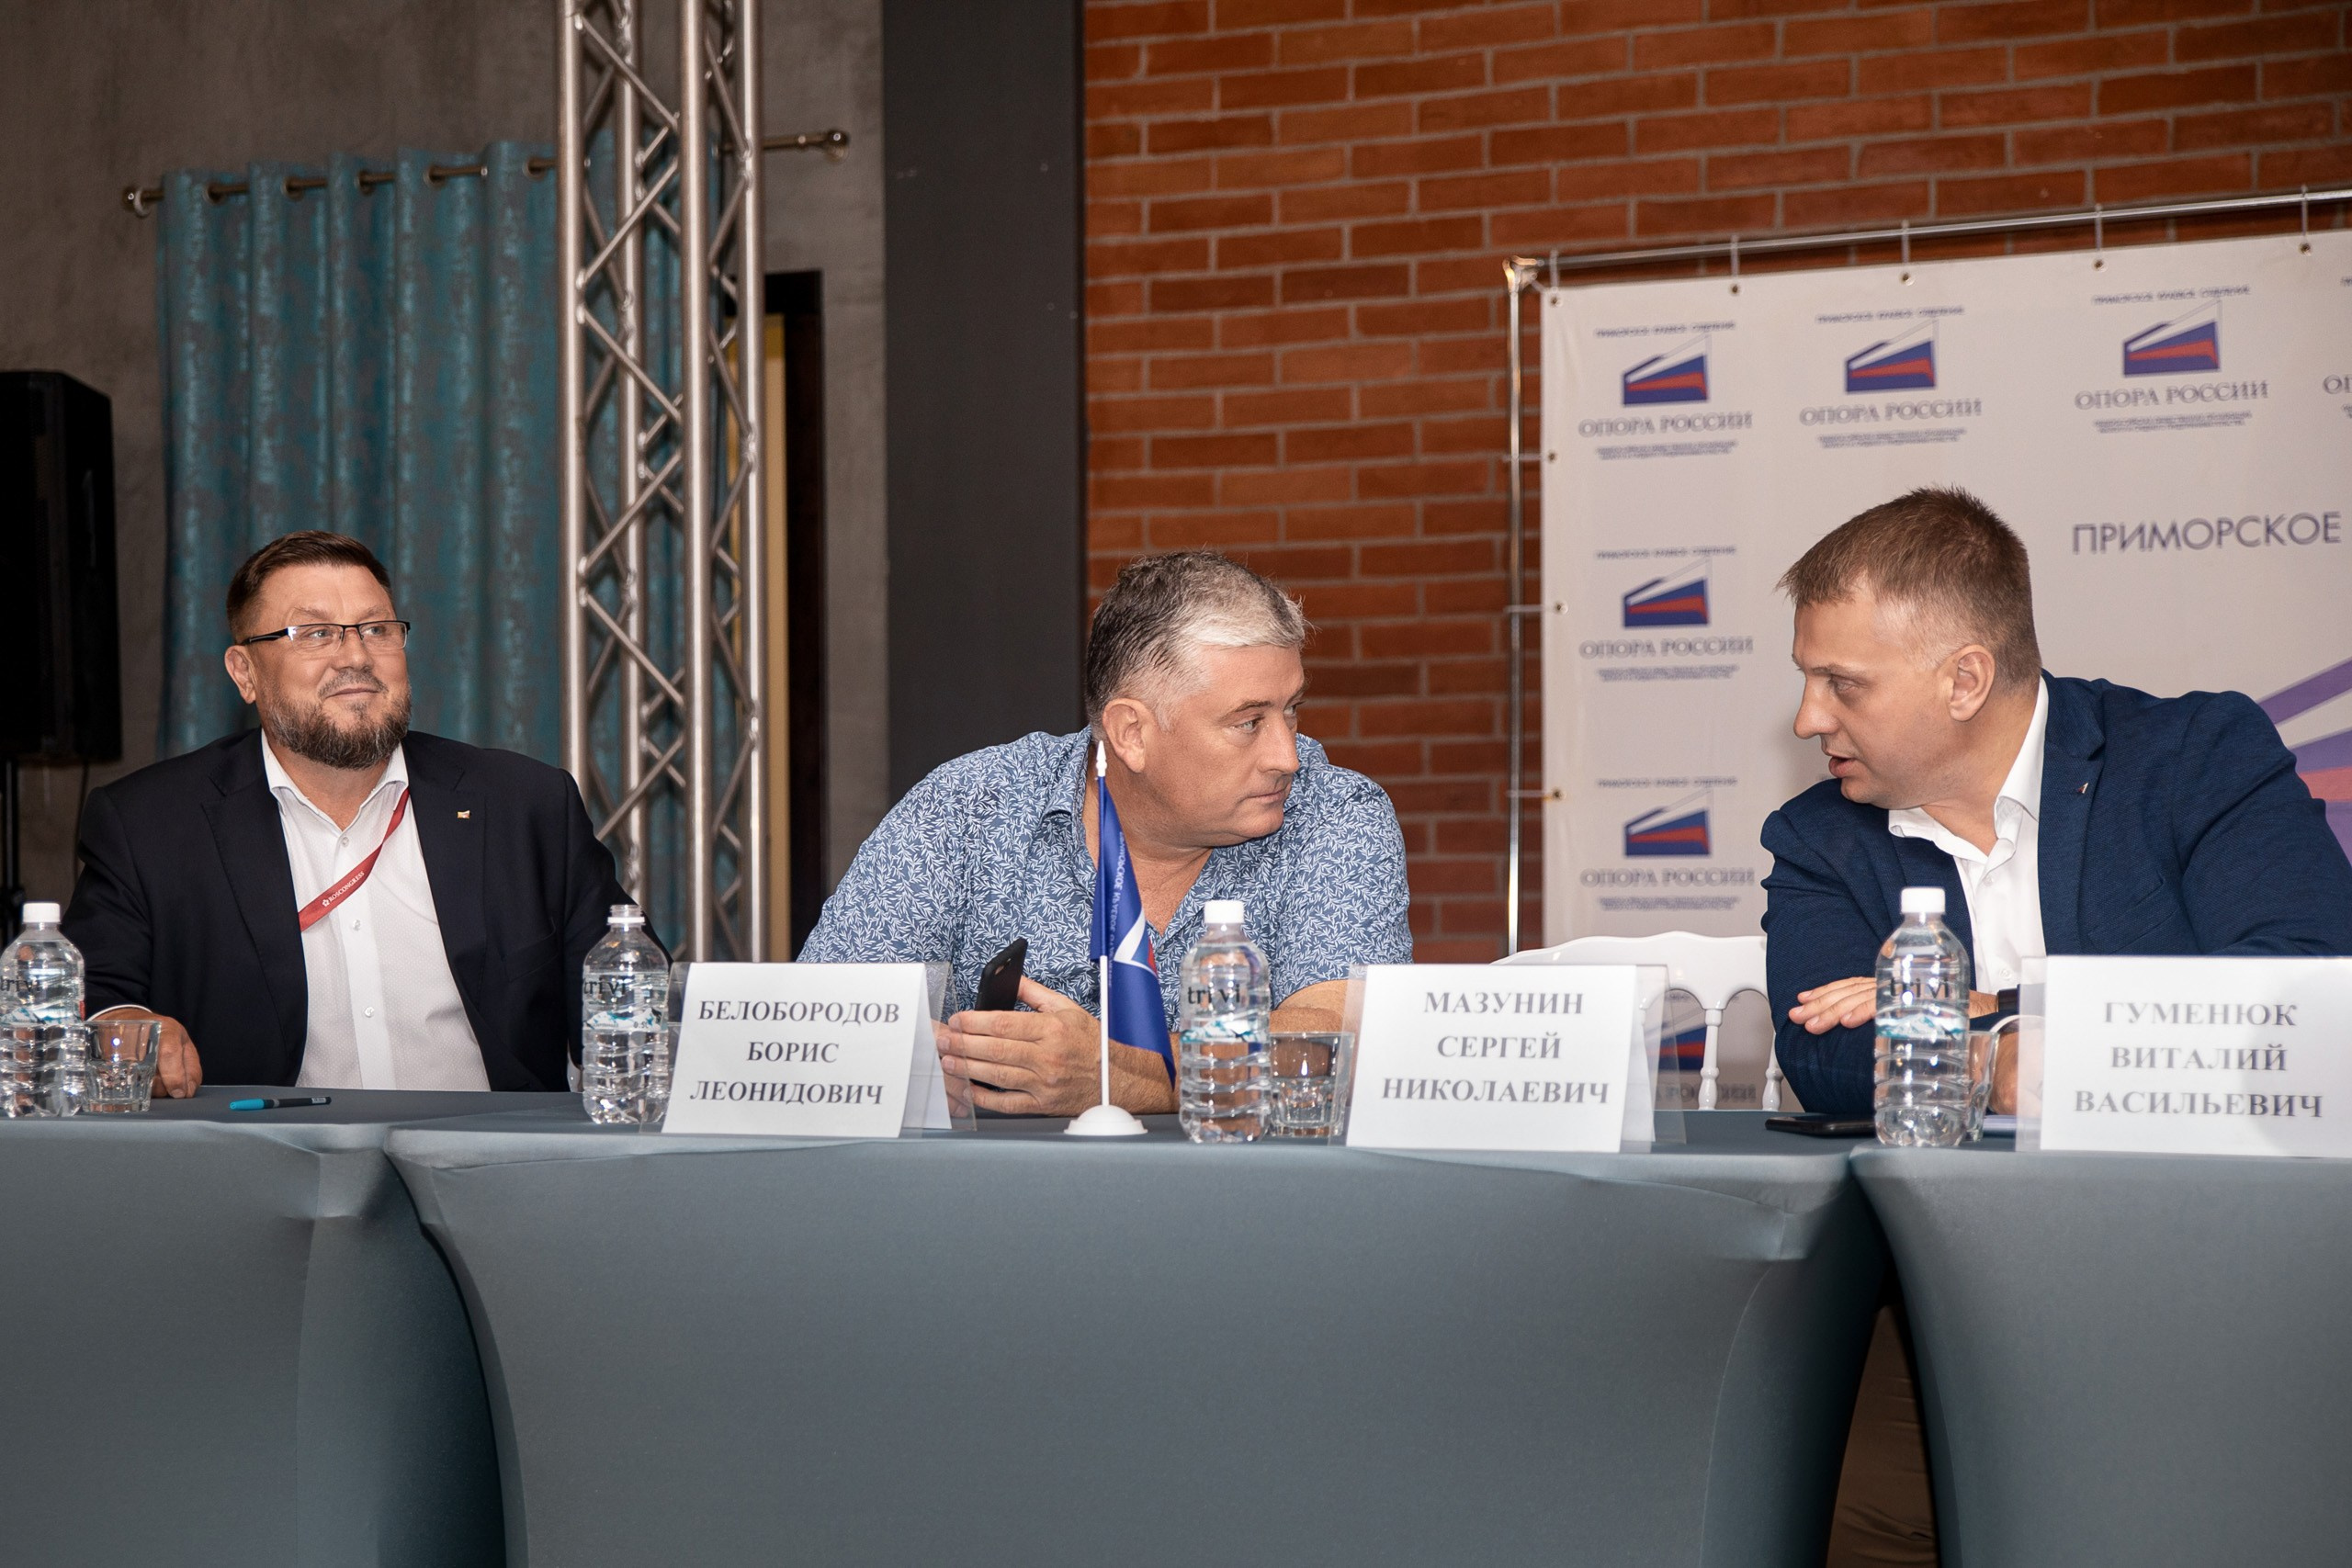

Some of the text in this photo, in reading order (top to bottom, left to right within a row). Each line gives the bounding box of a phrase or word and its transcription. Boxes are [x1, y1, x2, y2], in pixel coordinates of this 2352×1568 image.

[2075, 380, 2268, 411] ОПОРА РОССИИ
[1578, 412, 1753, 438] ОПОРА РОССИИ
[1800, 399, 1982, 426] ОПОРА РОССИИ
[2073, 511, 2342, 555] ПРИМОРСКОЕ
[1579, 636, 1753, 660] ОПОРА РОССИИ
[1580, 867, 1755, 888] ОПОРА РОССИИ
[1188, 984, 1240, 1004] trivi
[1424, 992, 1583, 1014] МАЗУНИН
[699, 1000, 899, 1025] БЕЛОБОРОДОВ
[2105, 1002, 2297, 1027] ГУМЕНЮК
[747, 1042, 839, 1063] БОРИС
[1437, 1032, 1561, 1059] СЕРГЕЙ
[2111, 1043, 2288, 1072] ВИТАЛИЙ
[690, 1081, 883, 1105] ЛЕОНИДОВИЧ
[1383, 1077, 1609, 1104] НИКОЛАЕВИЧ
[2075, 1091, 2324, 1119] ВАСИЛЬЕВИЧ
